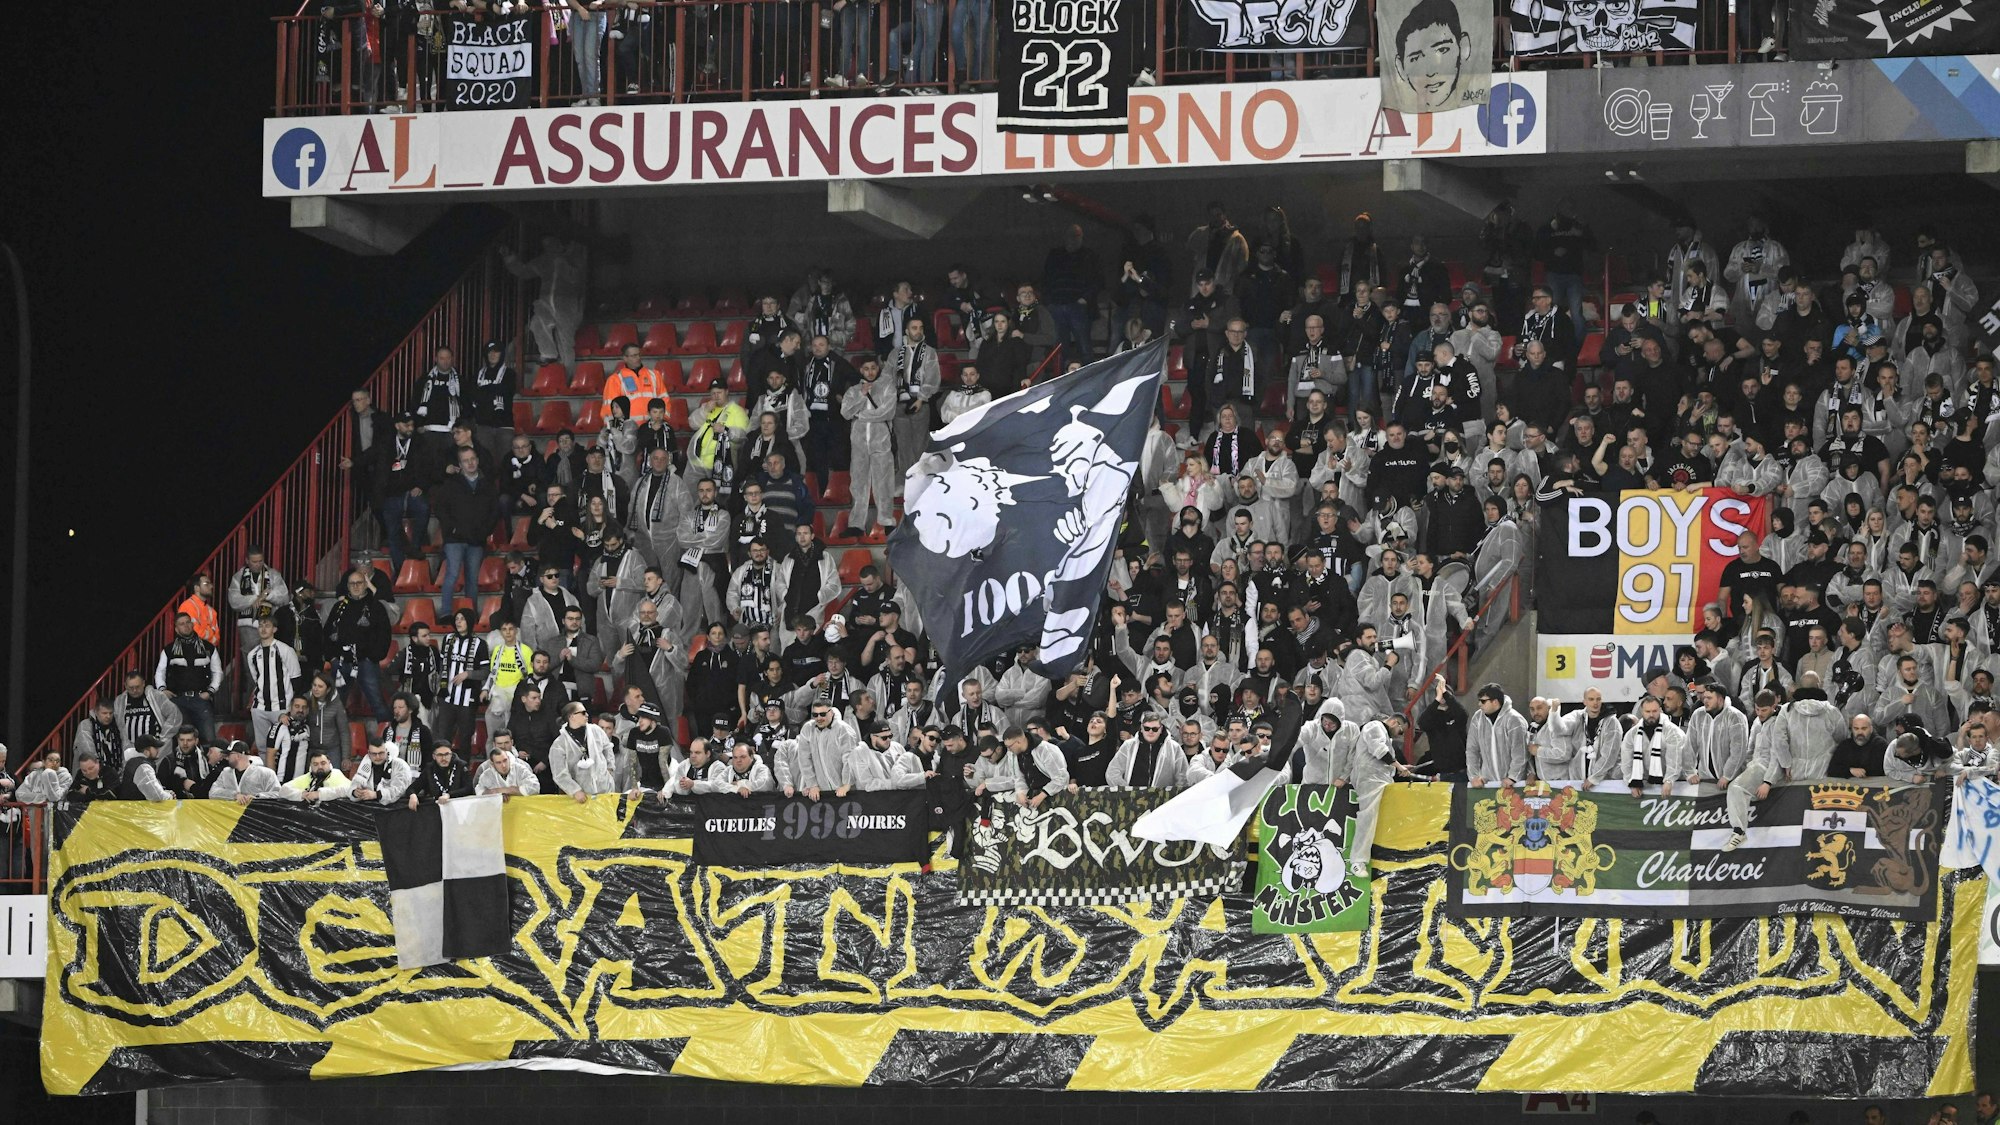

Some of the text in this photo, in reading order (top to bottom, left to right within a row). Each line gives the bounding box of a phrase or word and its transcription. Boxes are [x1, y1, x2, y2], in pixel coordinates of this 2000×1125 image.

[1012, 0, 1121, 33] BLOCK
[1905, 4, 1943, 28] CHARLEROI
[452, 19, 528, 45] BLACK
[1622, 23, 1639, 39] ON
[1623, 31, 1662, 50] TOUR
[451, 50, 526, 77] SQUAD
[1019, 39, 1111, 112] 22
[456, 80, 517, 105] 2020
[492, 99, 978, 187] ASSURANCES
[1567, 495, 1752, 557] BOYS
[1618, 563, 1695, 623] 91
[1555, 655, 1566, 671] 3
[1617, 644, 1692, 679] MA
[704, 815, 906, 832] GUEULES NOIRES
[760, 801, 863, 840] 1998
[1640, 799, 1757, 828] Münsr
[1636, 851, 1767, 888] Charleroi
[1253, 880, 1365, 927] MÜNSTER
[1777, 901, 1901, 919] Black & White Storm Ultras
